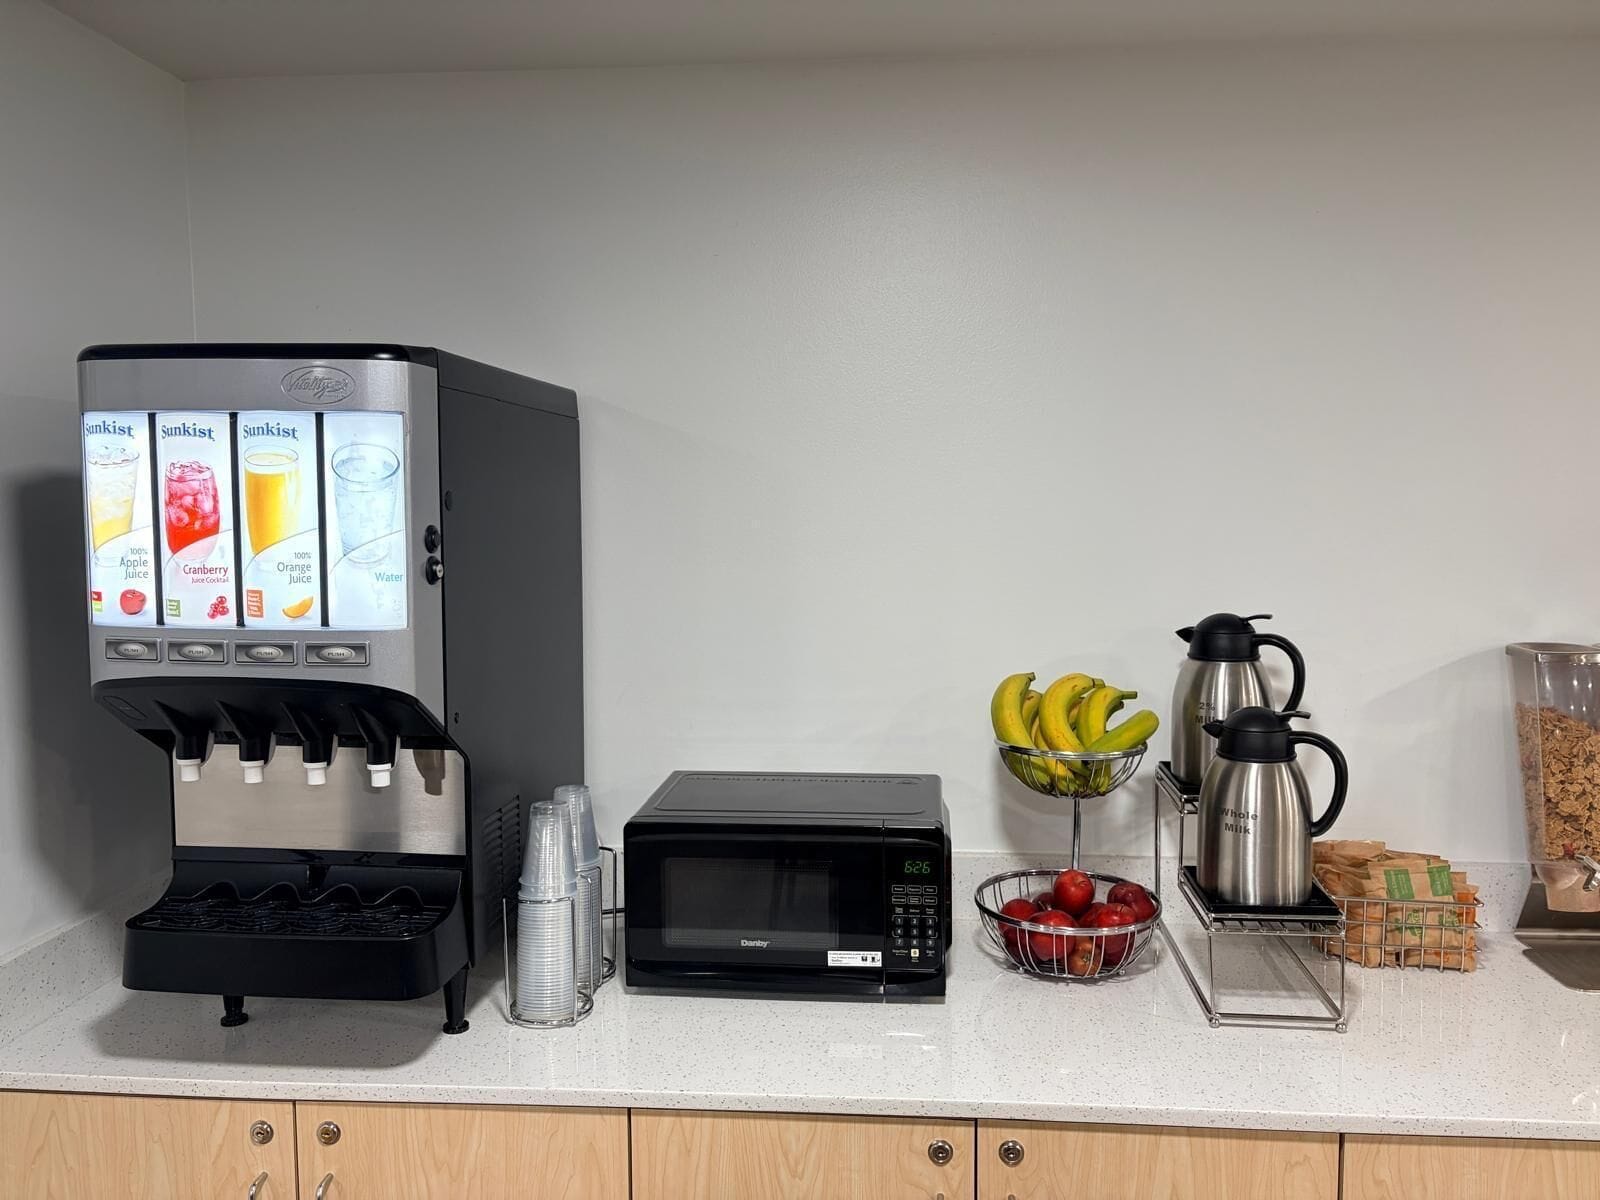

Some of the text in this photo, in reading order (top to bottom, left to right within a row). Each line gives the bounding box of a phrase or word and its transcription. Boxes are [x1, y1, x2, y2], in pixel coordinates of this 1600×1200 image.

[161, 422, 215, 441] Sunkist
[243, 422, 299, 441] Sunkist
[130, 547, 148, 555] 100%
[294, 551, 312, 559] 100%
[119, 557, 149, 570] Apple
[276, 561, 312, 574] Orange
[124, 568, 149, 580] Juice
[183, 564, 229, 577] Cranberry
[374, 572, 404, 582] Water
[191, 576, 229, 584] Juice Cocktail
[288, 572, 312, 585] Juice
[1199, 701, 1216, 712] 2%
[1220, 807, 1258, 821] Whole
[1224, 822, 1251, 835] Milk
[740, 939, 769, 948] Danby
